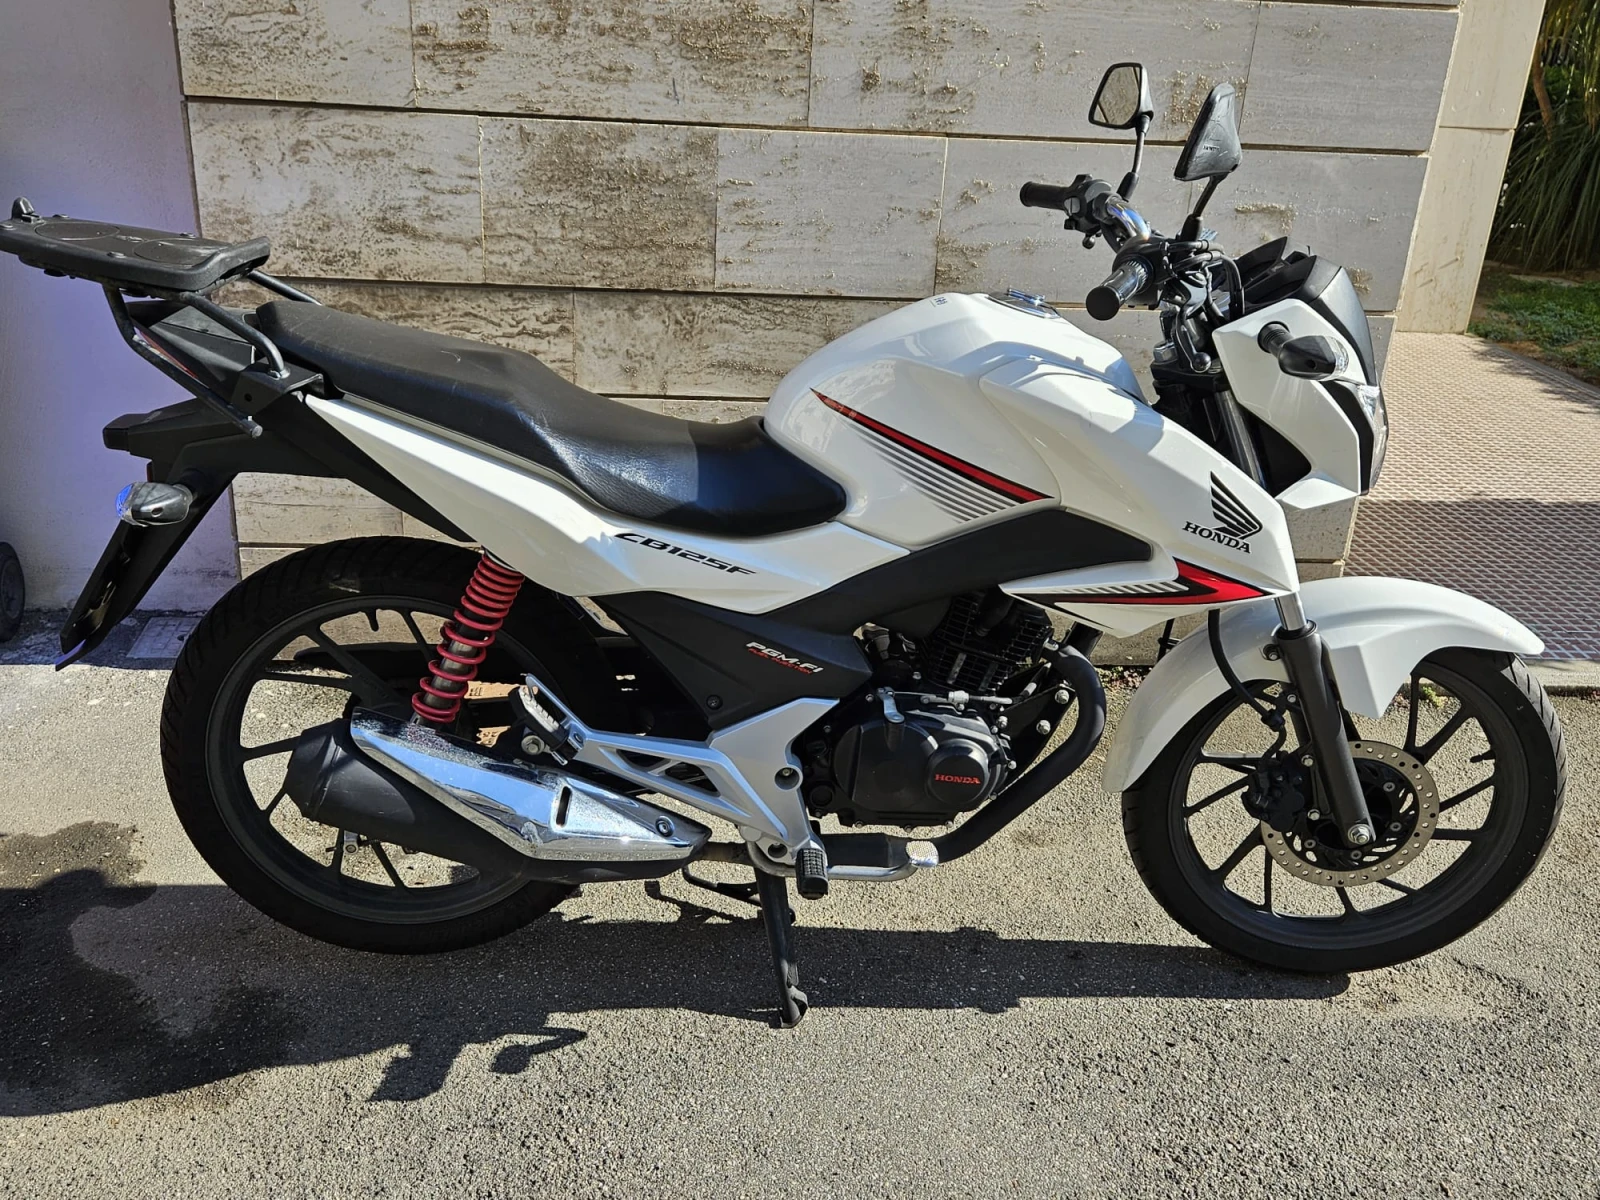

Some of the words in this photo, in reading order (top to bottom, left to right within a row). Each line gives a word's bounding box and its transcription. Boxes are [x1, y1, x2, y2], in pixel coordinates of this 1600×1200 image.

[1182, 521, 1251, 553] HONDA
[614, 532, 757, 575] CB125F
[934, 773, 981, 784] HONDA
